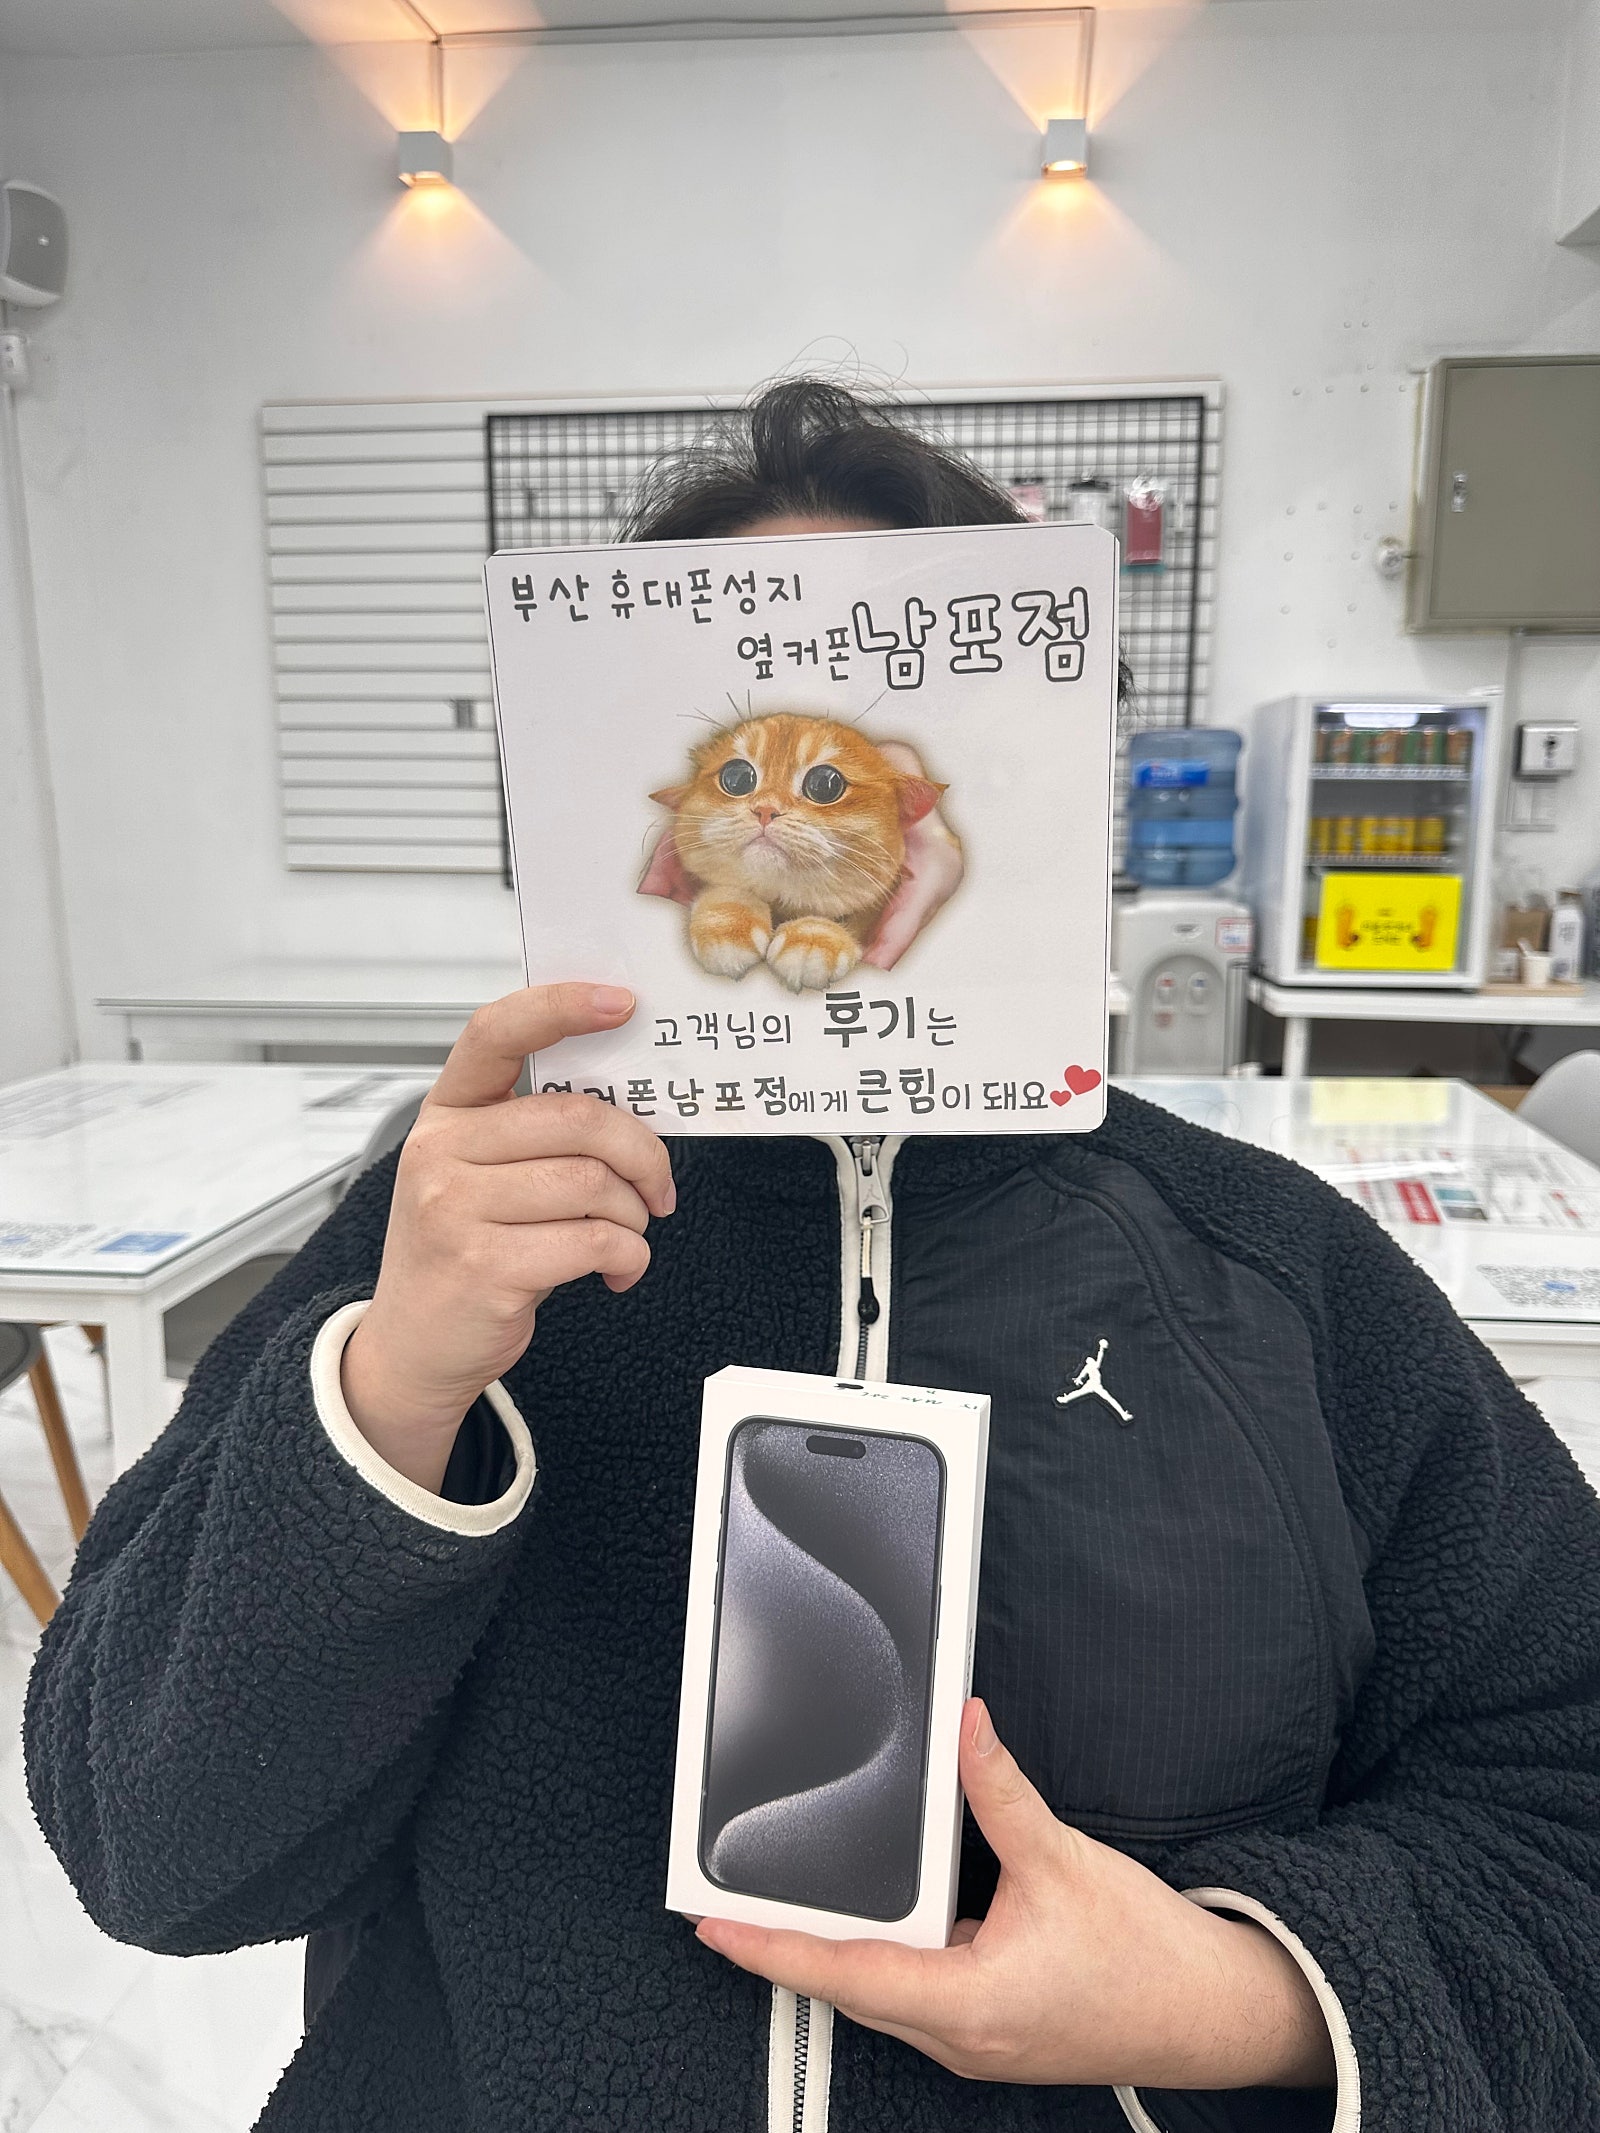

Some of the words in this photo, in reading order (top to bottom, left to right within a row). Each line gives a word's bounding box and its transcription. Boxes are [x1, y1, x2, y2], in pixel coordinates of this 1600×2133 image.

[511, 574, 590, 623] 부산
[610, 568, 803, 624] 휴대폰성지
[653, 1010, 792, 1050] 고객님의
[982, 1080, 1049, 1112] 돼요
